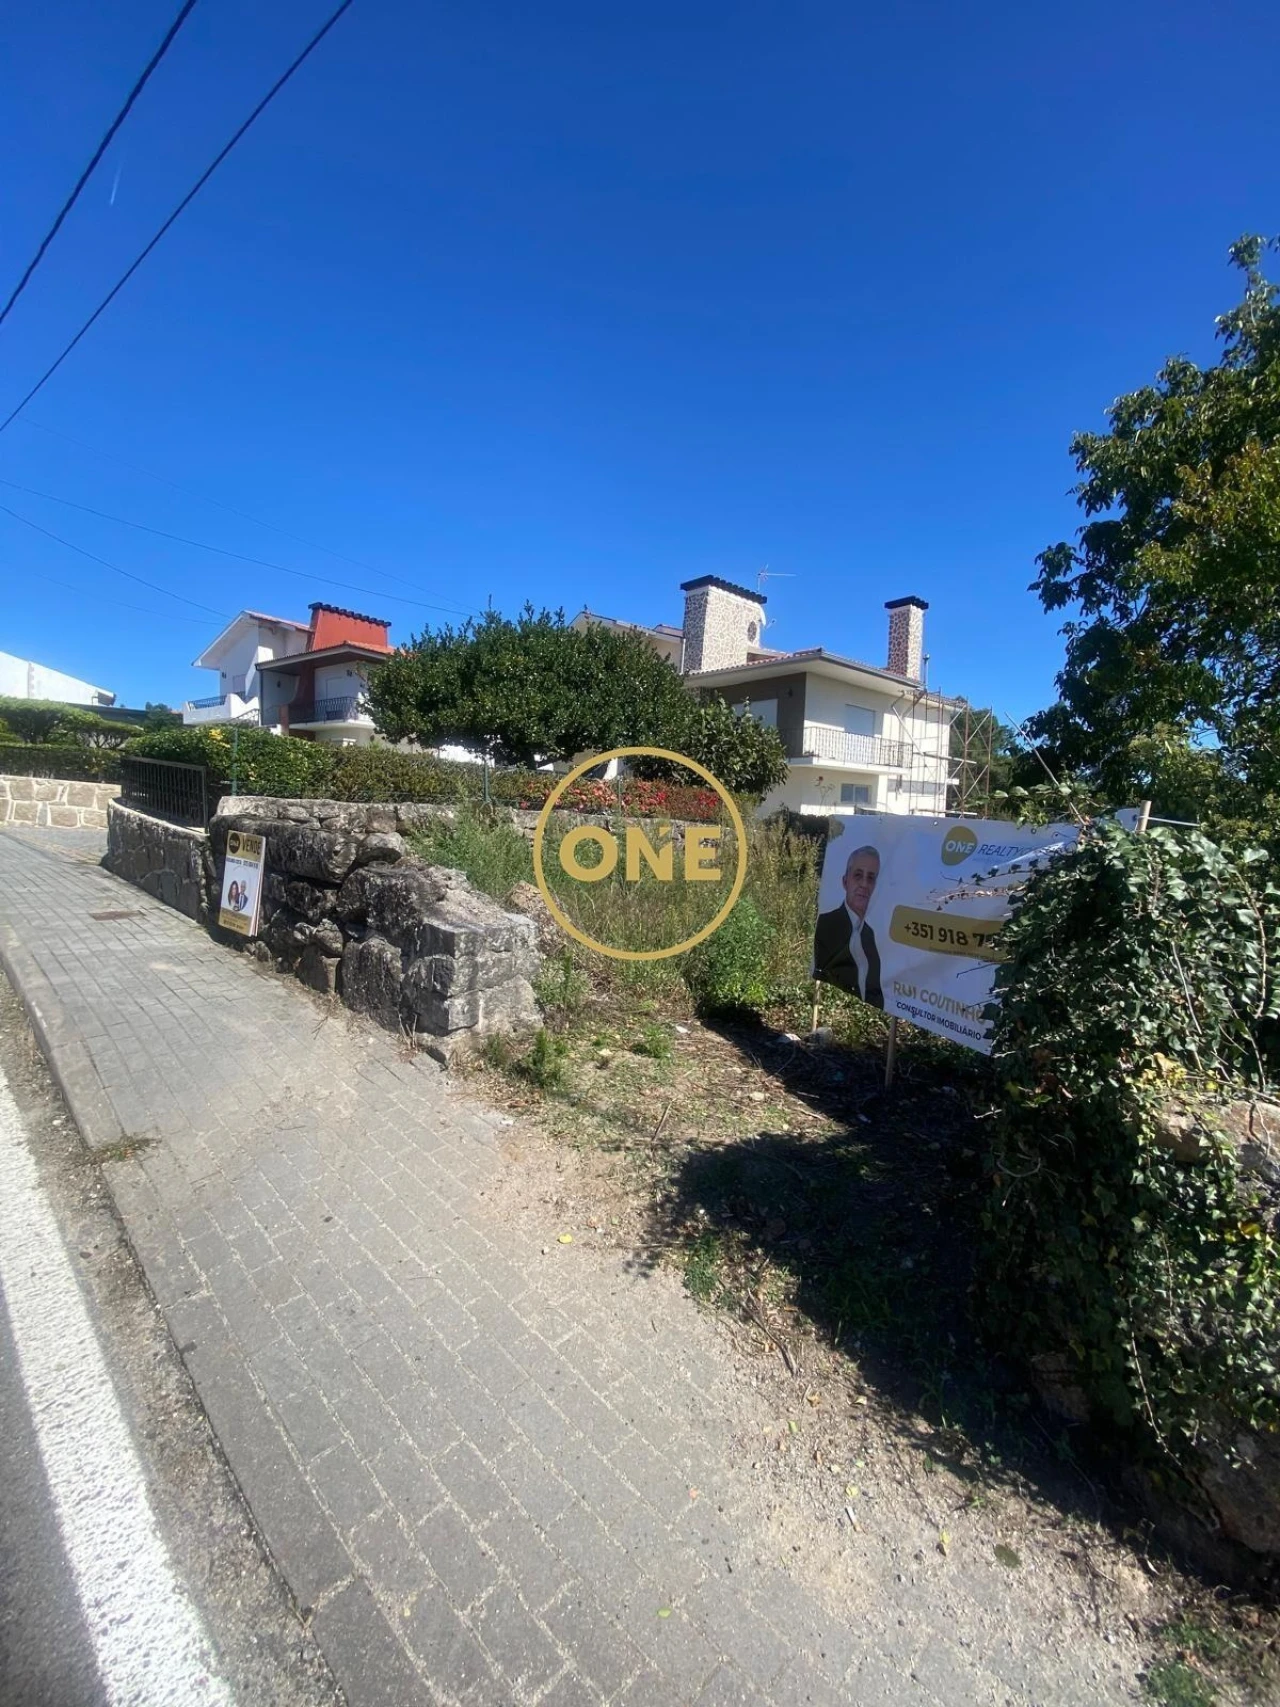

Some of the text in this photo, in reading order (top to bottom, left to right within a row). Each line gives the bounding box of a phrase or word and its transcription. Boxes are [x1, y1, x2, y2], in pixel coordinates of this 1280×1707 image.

[945, 840, 975, 854] ONE
[904, 921, 934, 940] +351
[938, 927, 969, 946] 918
[893, 981, 917, 999] RUI
[896, 1001, 982, 1041] CONSULTOR IMOBILIÁRIO
